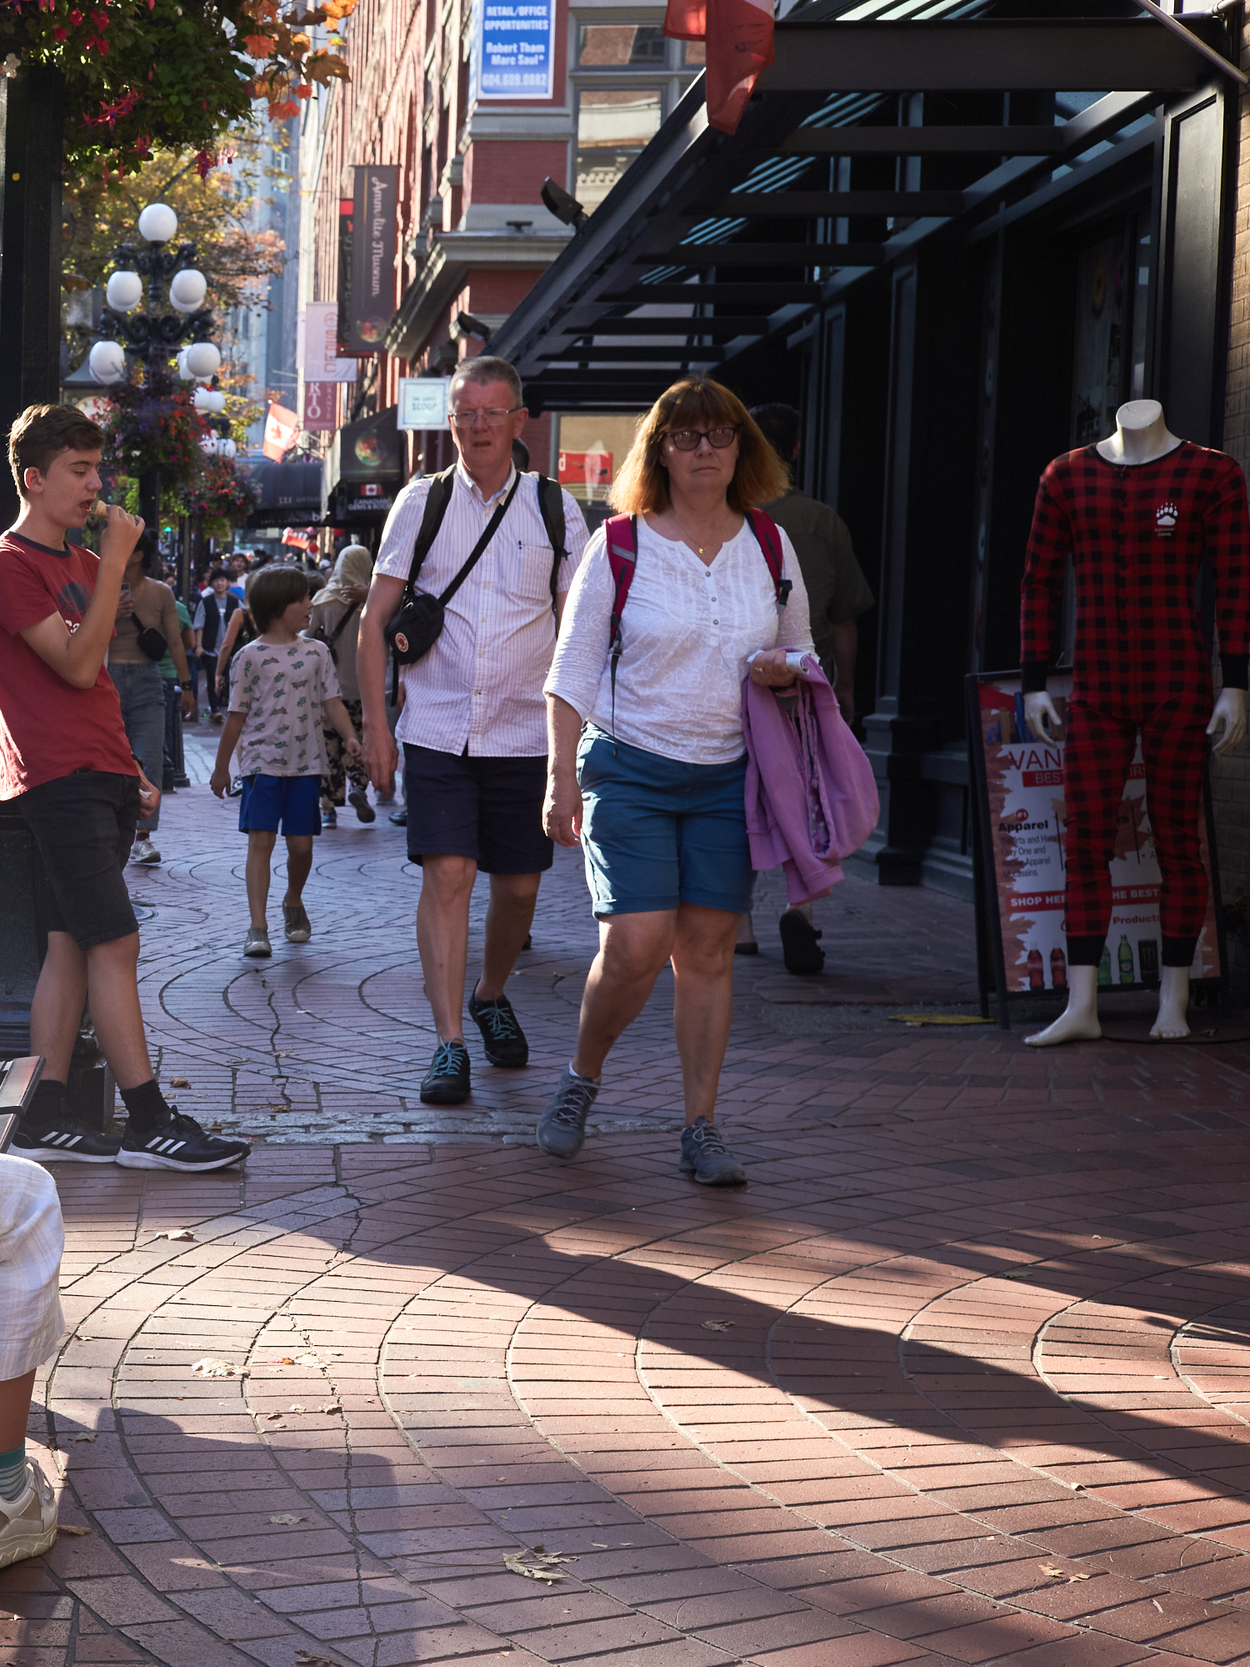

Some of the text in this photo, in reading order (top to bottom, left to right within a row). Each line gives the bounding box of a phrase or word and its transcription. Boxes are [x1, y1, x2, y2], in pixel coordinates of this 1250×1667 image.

[486, 5, 548, 17] RETAIL/OFFICE
[484, 19, 549, 31] OPPORTUNITIES
[486, 41, 546, 53] Robert Tham
[491, 54, 516, 65] Marc
[371, 240, 385, 298] Museum
[998, 820, 1049, 833] Apparel
[1027, 835, 1040, 844] and
[1040, 834, 1057, 843] Hats
[1018, 846, 1032, 855] One
[1033, 846, 1046, 855] and
[1024, 856, 1051, 867] Apparel
[1130, 888, 1159, 900] BEST
[1010, 896, 1043, 907] SHOP
